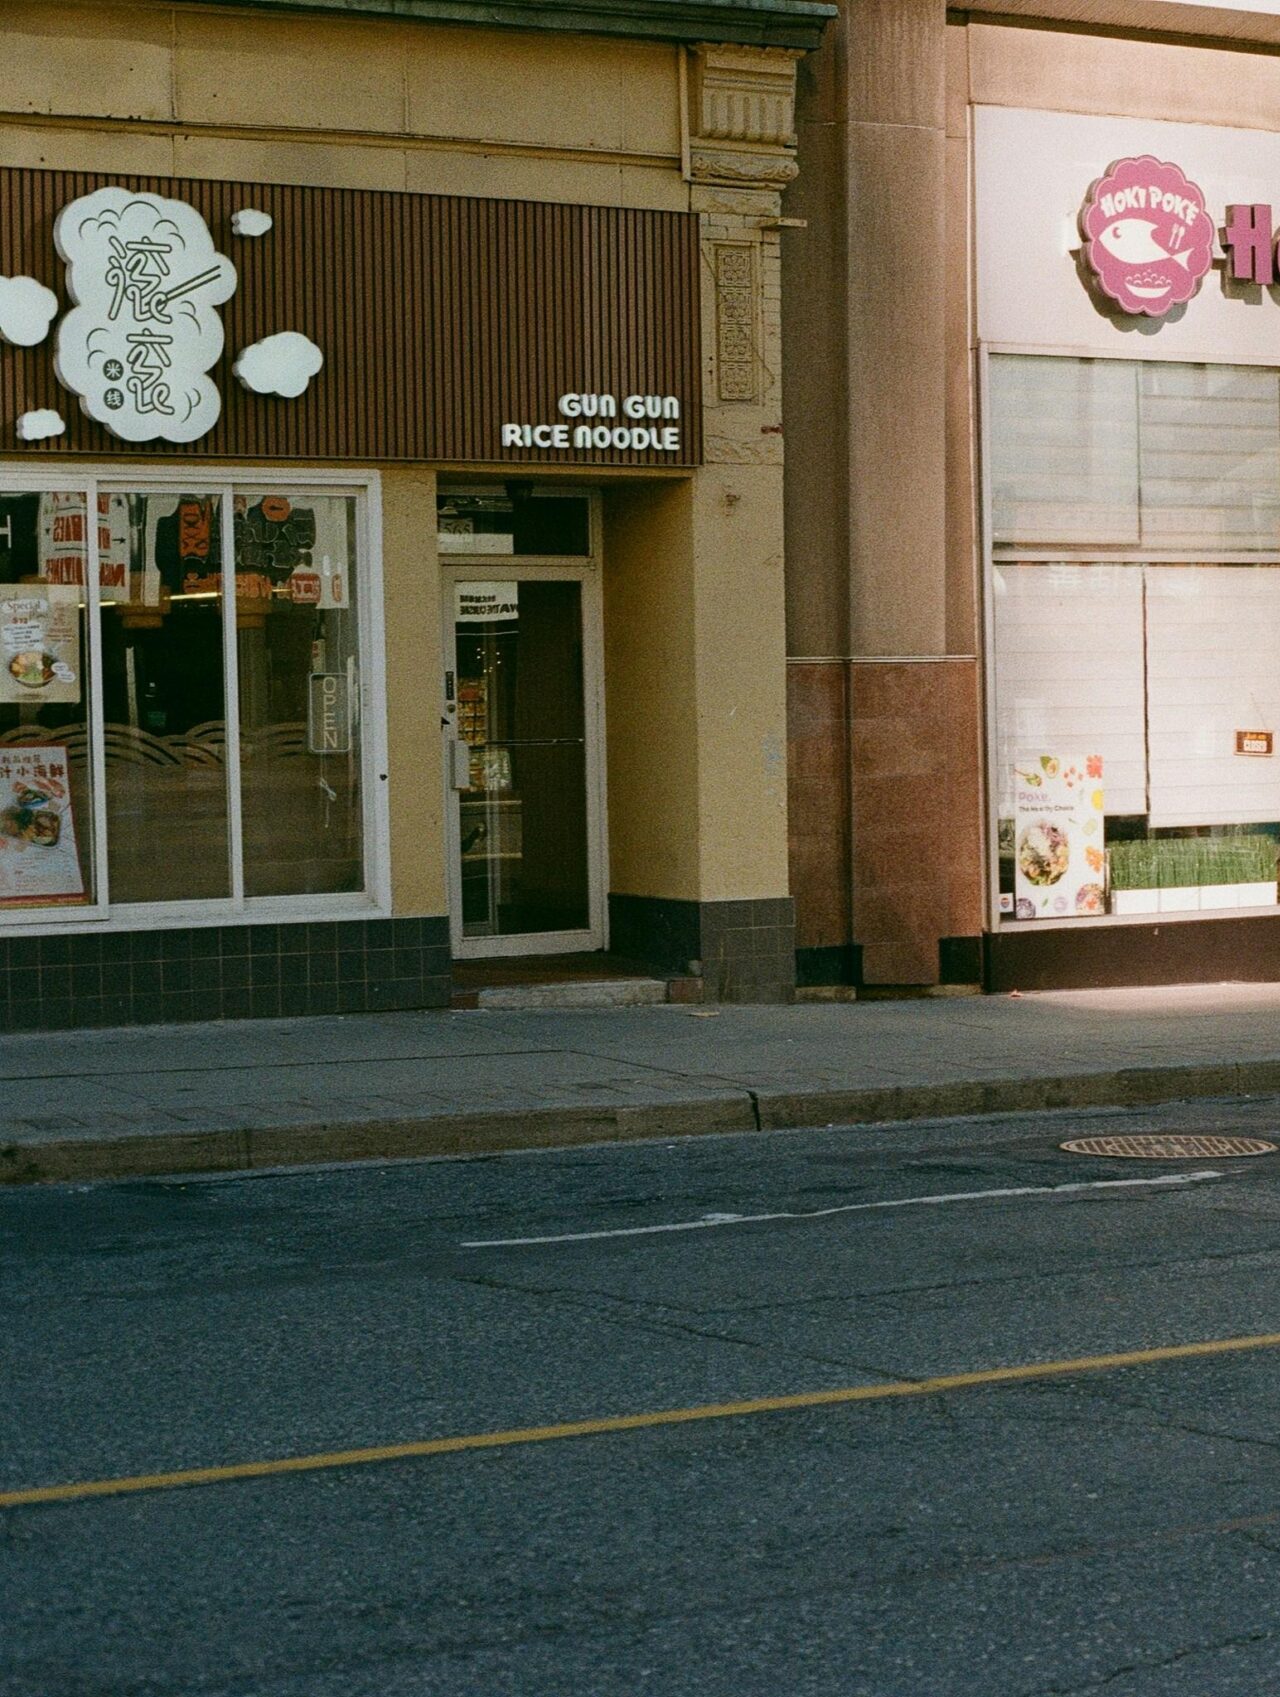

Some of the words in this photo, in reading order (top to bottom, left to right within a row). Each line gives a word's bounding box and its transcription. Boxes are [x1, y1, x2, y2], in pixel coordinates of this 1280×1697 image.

[1100, 185, 1146, 218] HOKI
[1149, 185, 1199, 226] POKE
[558, 392, 616, 418] GUN
[622, 394, 680, 419] GUN
[501, 423, 570, 449] RICE
[573, 425, 681, 451] NOODLE
[321, 676, 338, 749] OPEN
